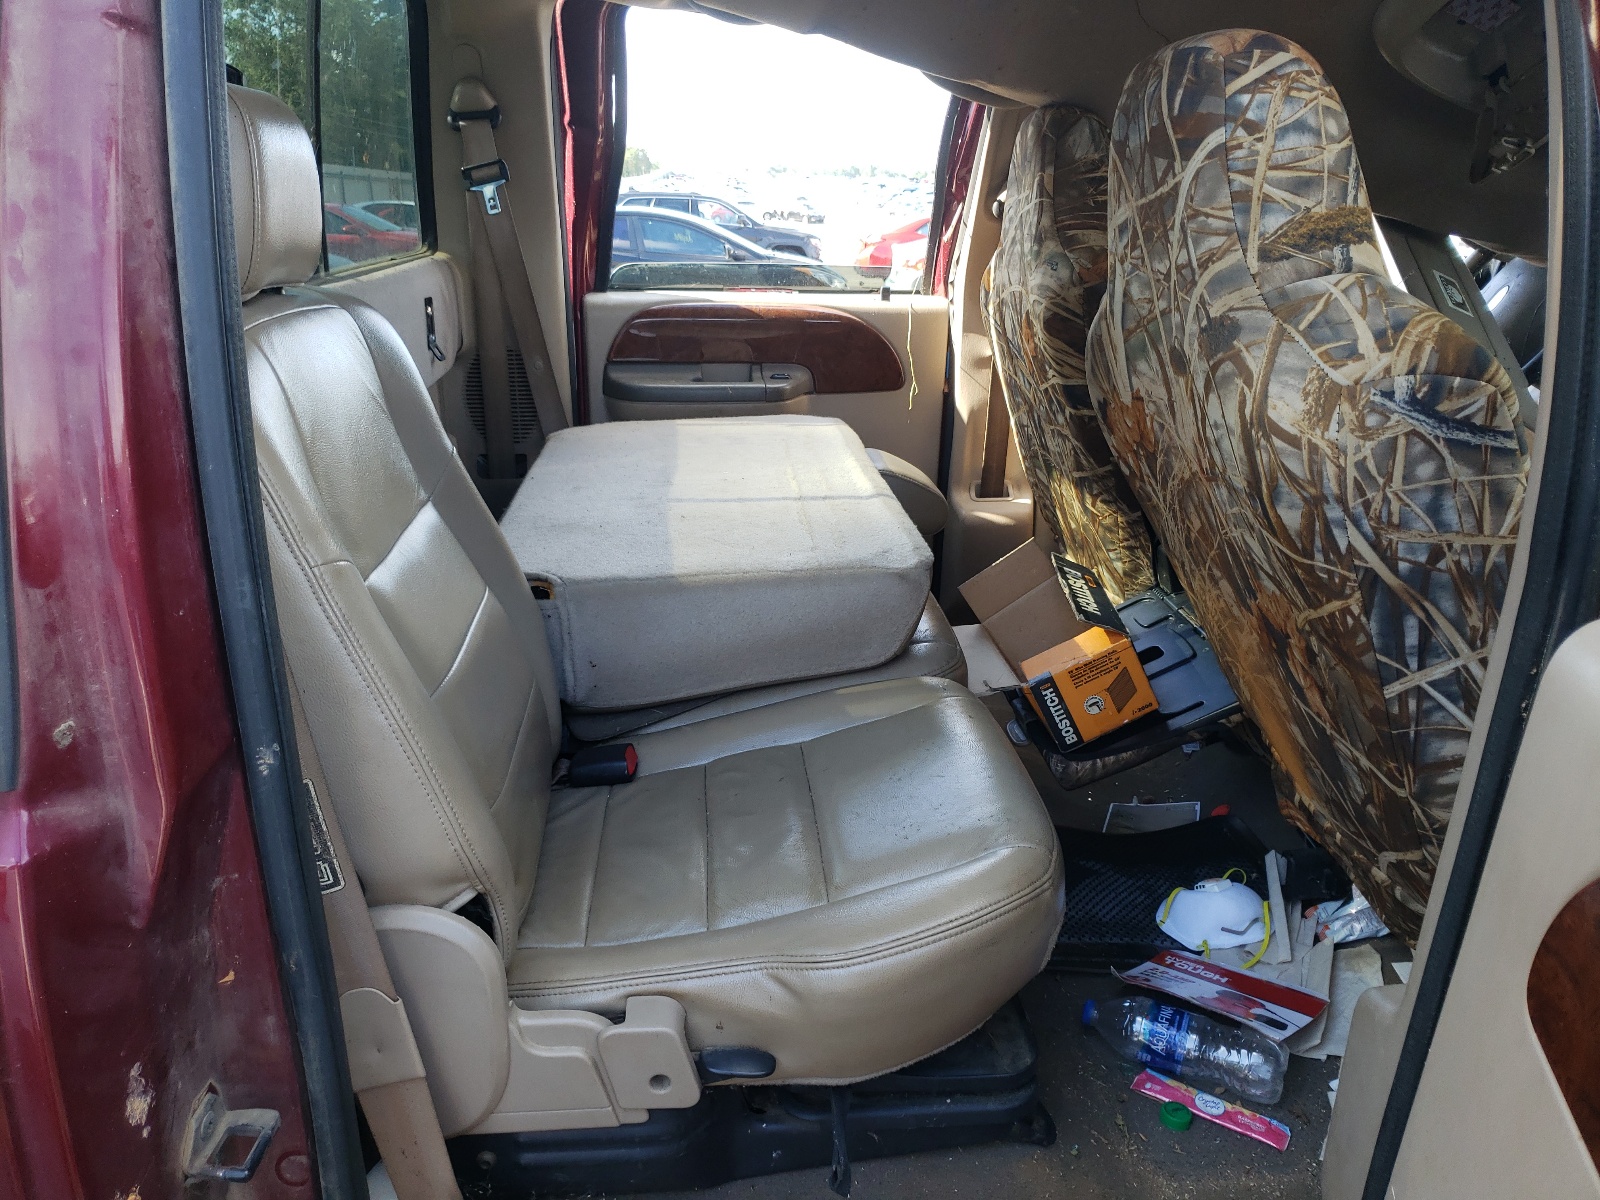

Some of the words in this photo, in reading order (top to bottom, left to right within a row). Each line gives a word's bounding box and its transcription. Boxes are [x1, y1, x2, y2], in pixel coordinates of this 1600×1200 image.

[1063, 567, 1102, 616] BOSTITCH
[1043, 688, 1079, 745] BOSTITCH
[1164, 959, 1230, 984] TOUGH
